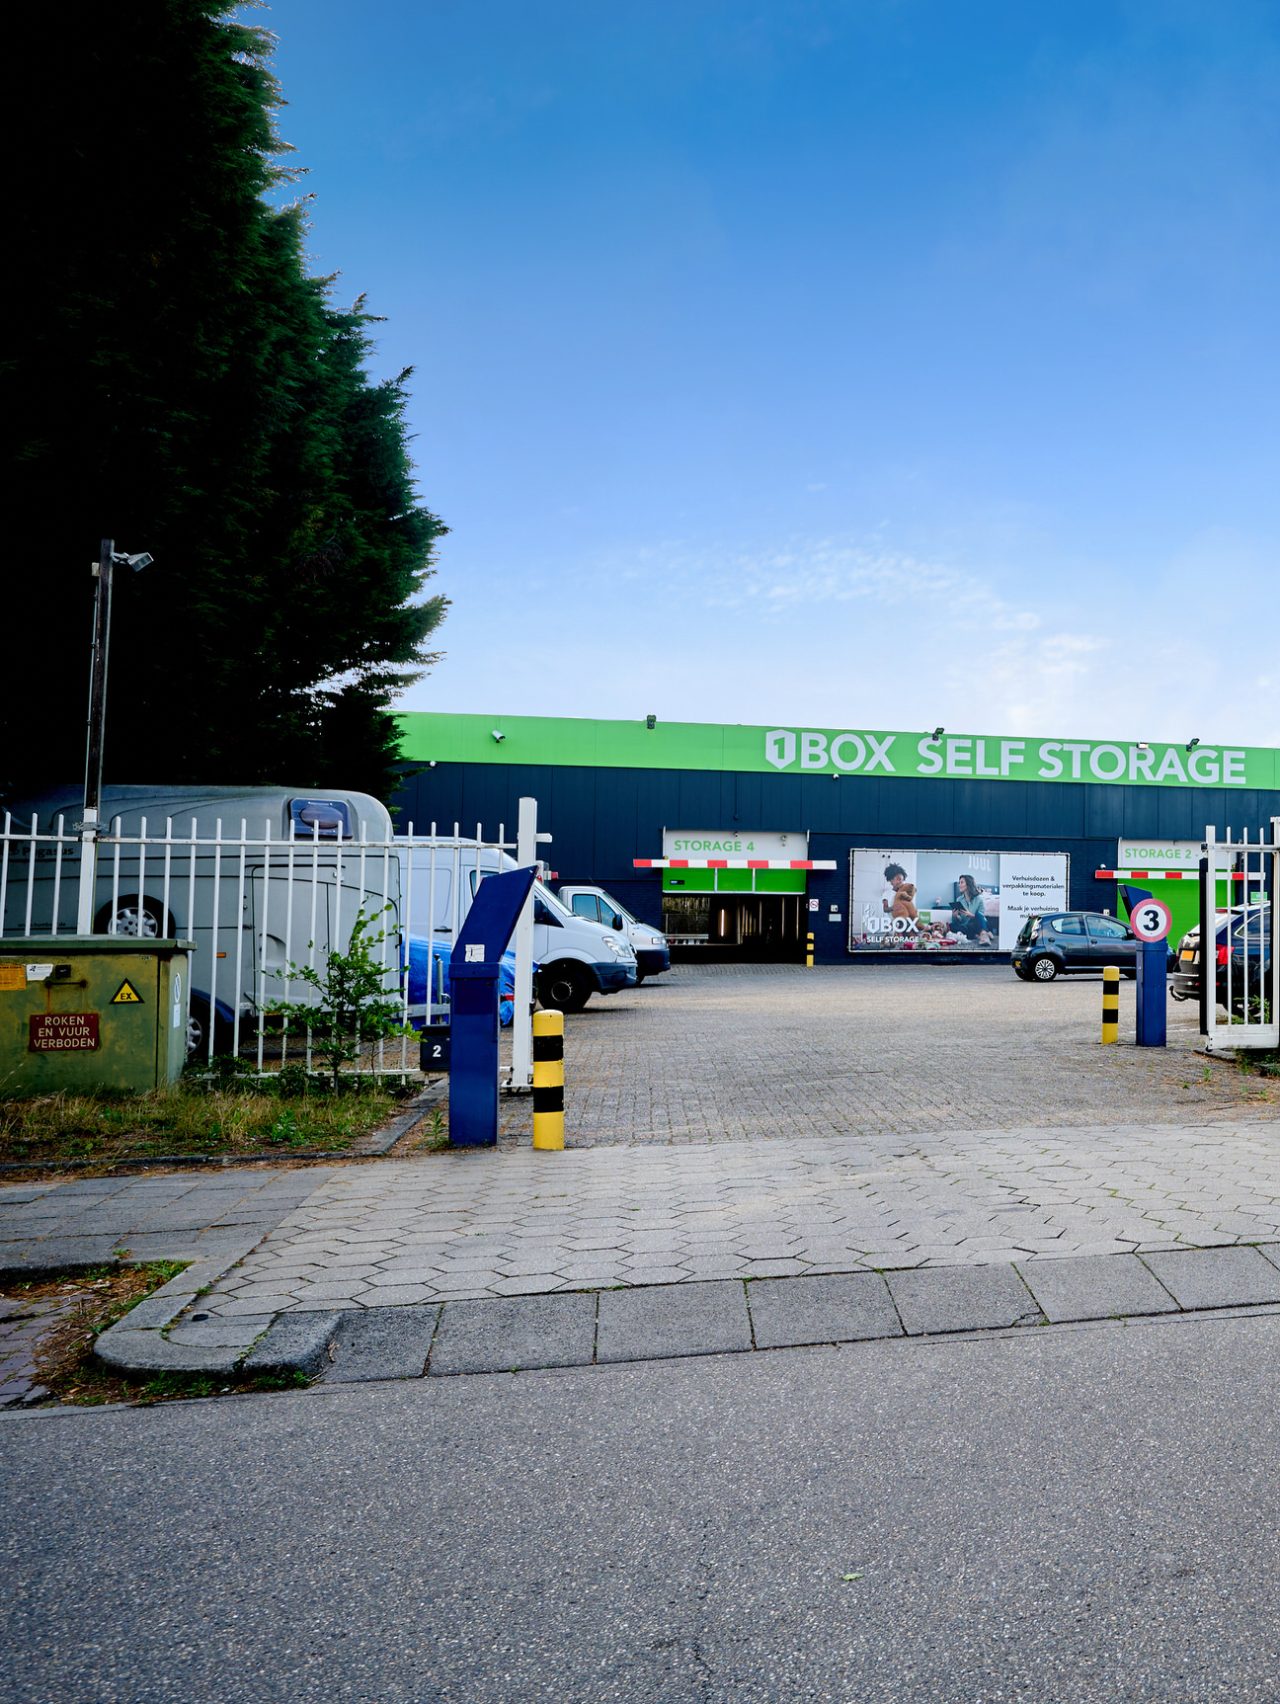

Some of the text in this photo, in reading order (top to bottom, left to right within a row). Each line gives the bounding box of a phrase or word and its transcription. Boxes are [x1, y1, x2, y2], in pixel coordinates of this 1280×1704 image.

[917, 737, 1026, 776] SELF
[1037, 743, 1247, 784] STORAGE
[674, 840, 755, 851] STORAGE 4
[1125, 848, 1192, 859] STORAGE 2
[1143, 910, 1160, 931] 3
[120, 992, 132, 1000] EX
[44, 1016, 84, 1026] ROKEN
[38, 1027, 90, 1037] EN VUUR
[34, 1038, 95, 1049] VERBODEN
[432, 1045, 442, 1058] 2
